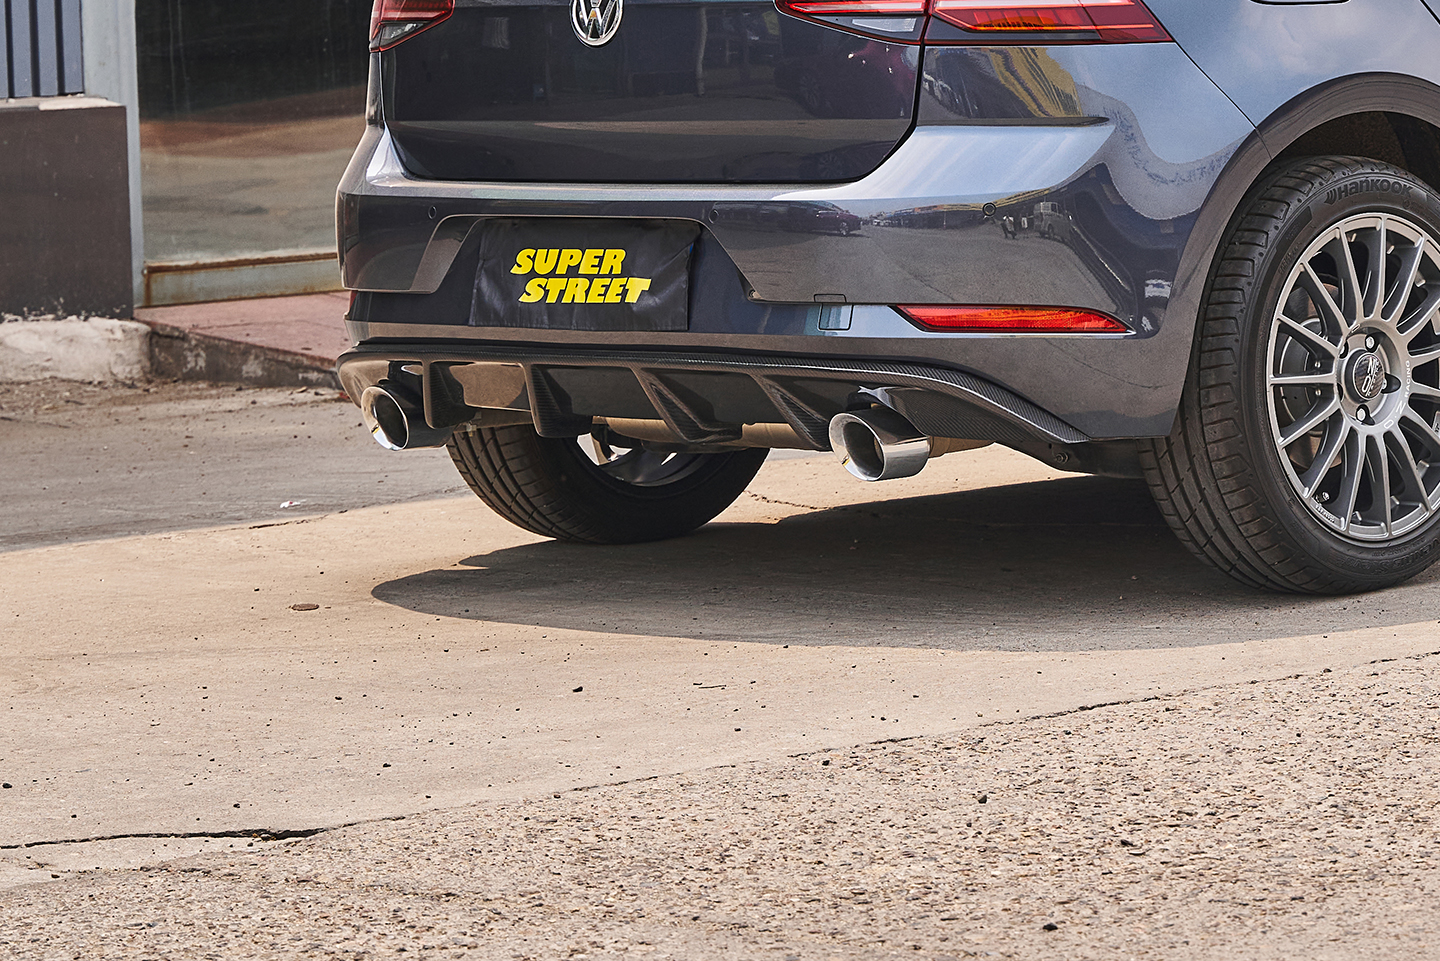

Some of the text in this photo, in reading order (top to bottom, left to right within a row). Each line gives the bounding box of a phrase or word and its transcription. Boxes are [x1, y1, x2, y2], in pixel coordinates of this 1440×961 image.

[509, 247, 626, 276] SUPER
[517, 276, 652, 305] STREET
[1403, 360, 1412, 399] RACING
